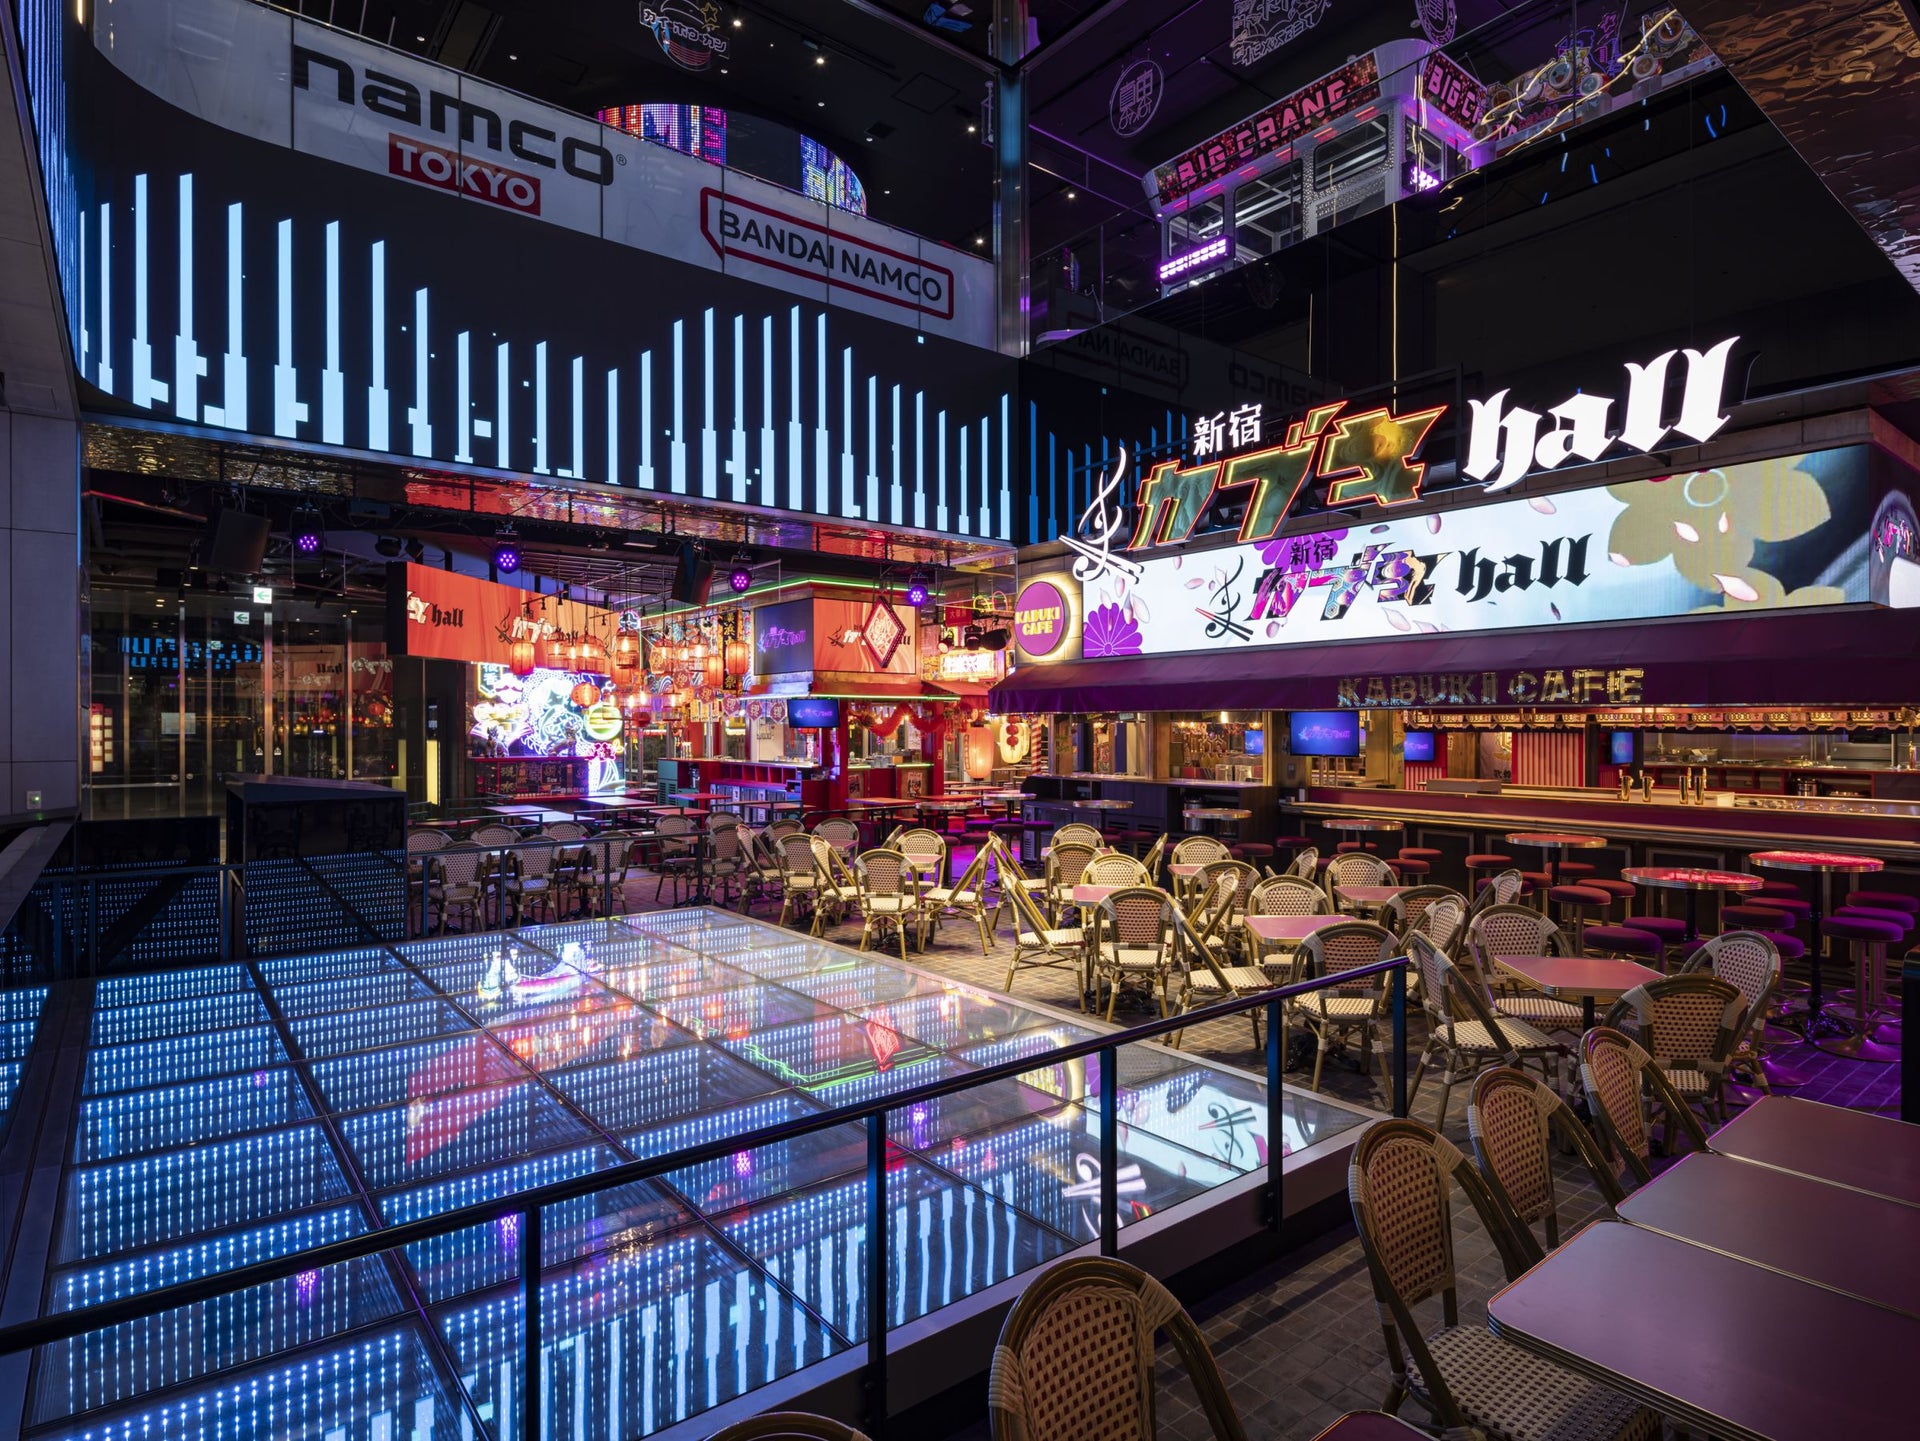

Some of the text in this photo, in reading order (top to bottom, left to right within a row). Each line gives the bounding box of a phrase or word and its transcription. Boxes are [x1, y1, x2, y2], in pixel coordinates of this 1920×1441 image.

[292, 44, 615, 186] namco
[1427, 64, 1460, 108] BIG
[1178, 79, 1347, 188] BIG CRANE
[396, 141, 536, 207] TOKYO
[719, 209, 942, 301] BANDAI NAMCO
[1193, 403, 1262, 456] 新宿
[1462, 335, 1741, 494] hall
[1290, 537, 1334, 565] 新宿
[1455, 533, 1593, 603] hall
[1022, 620, 1053, 636] CAFE
[1337, 668, 1644, 707] KABUKI CAFE
